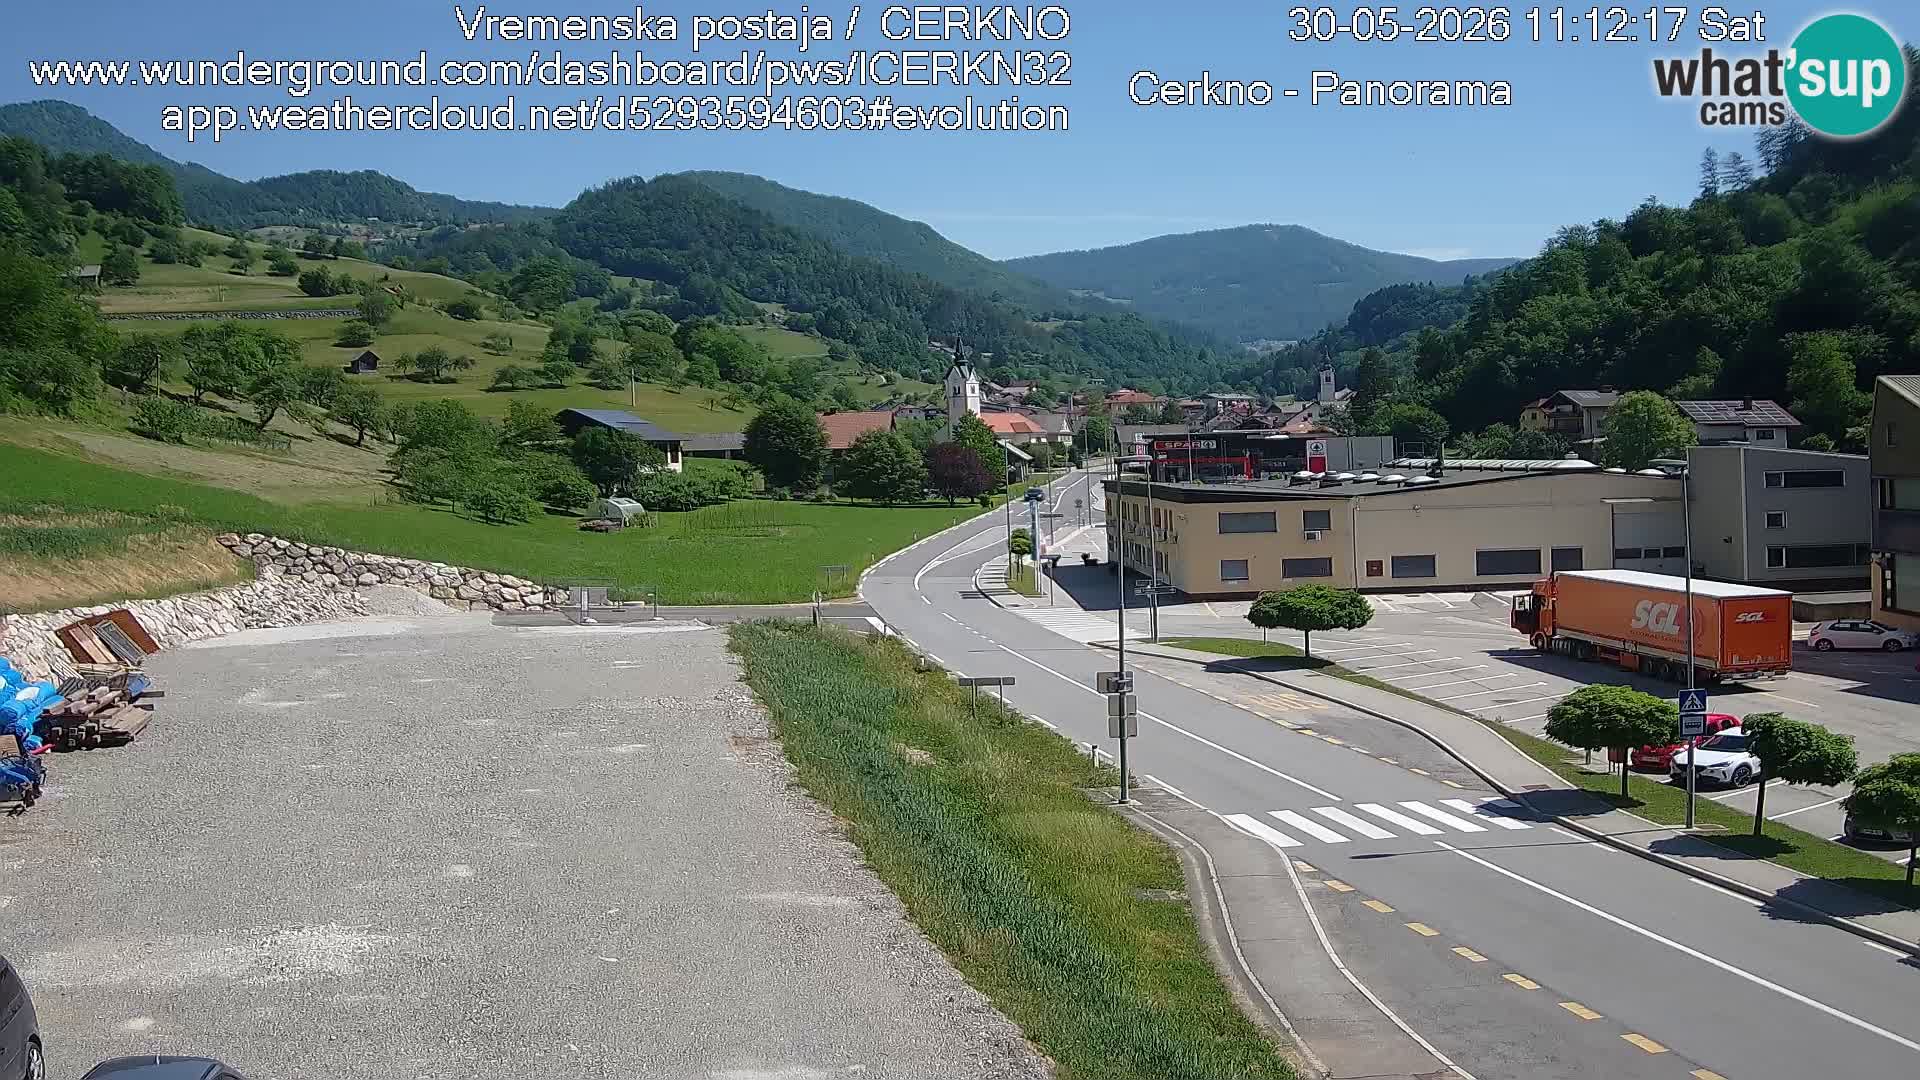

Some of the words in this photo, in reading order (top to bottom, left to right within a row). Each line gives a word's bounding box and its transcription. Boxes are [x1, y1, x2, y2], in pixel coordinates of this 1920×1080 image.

[1165, 441, 1201, 449] SPAR
[1631, 599, 1681, 635] SGL
[1735, 611, 1765, 622] SGL
